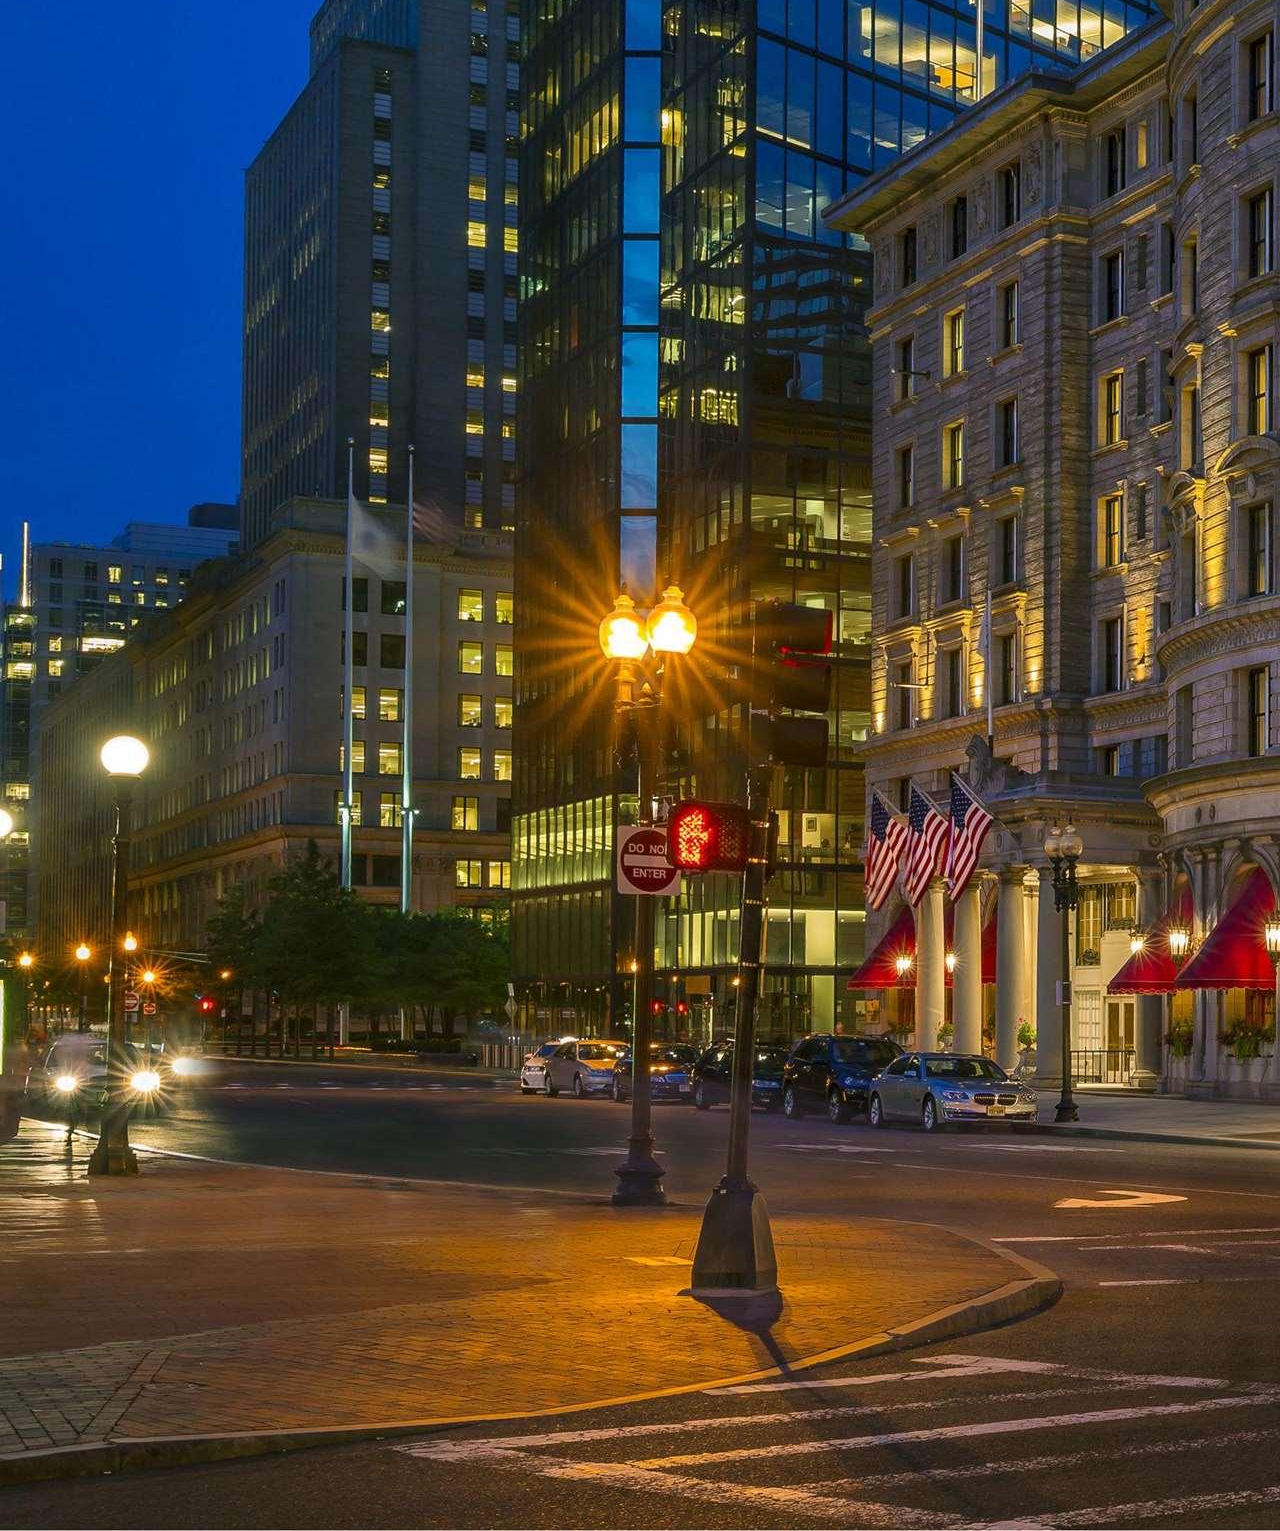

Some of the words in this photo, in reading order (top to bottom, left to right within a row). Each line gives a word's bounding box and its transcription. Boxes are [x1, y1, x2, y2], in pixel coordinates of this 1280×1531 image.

[629, 843, 645, 853] DO
[649, 844, 666, 854] NO
[633, 868, 666, 879] ENTER
